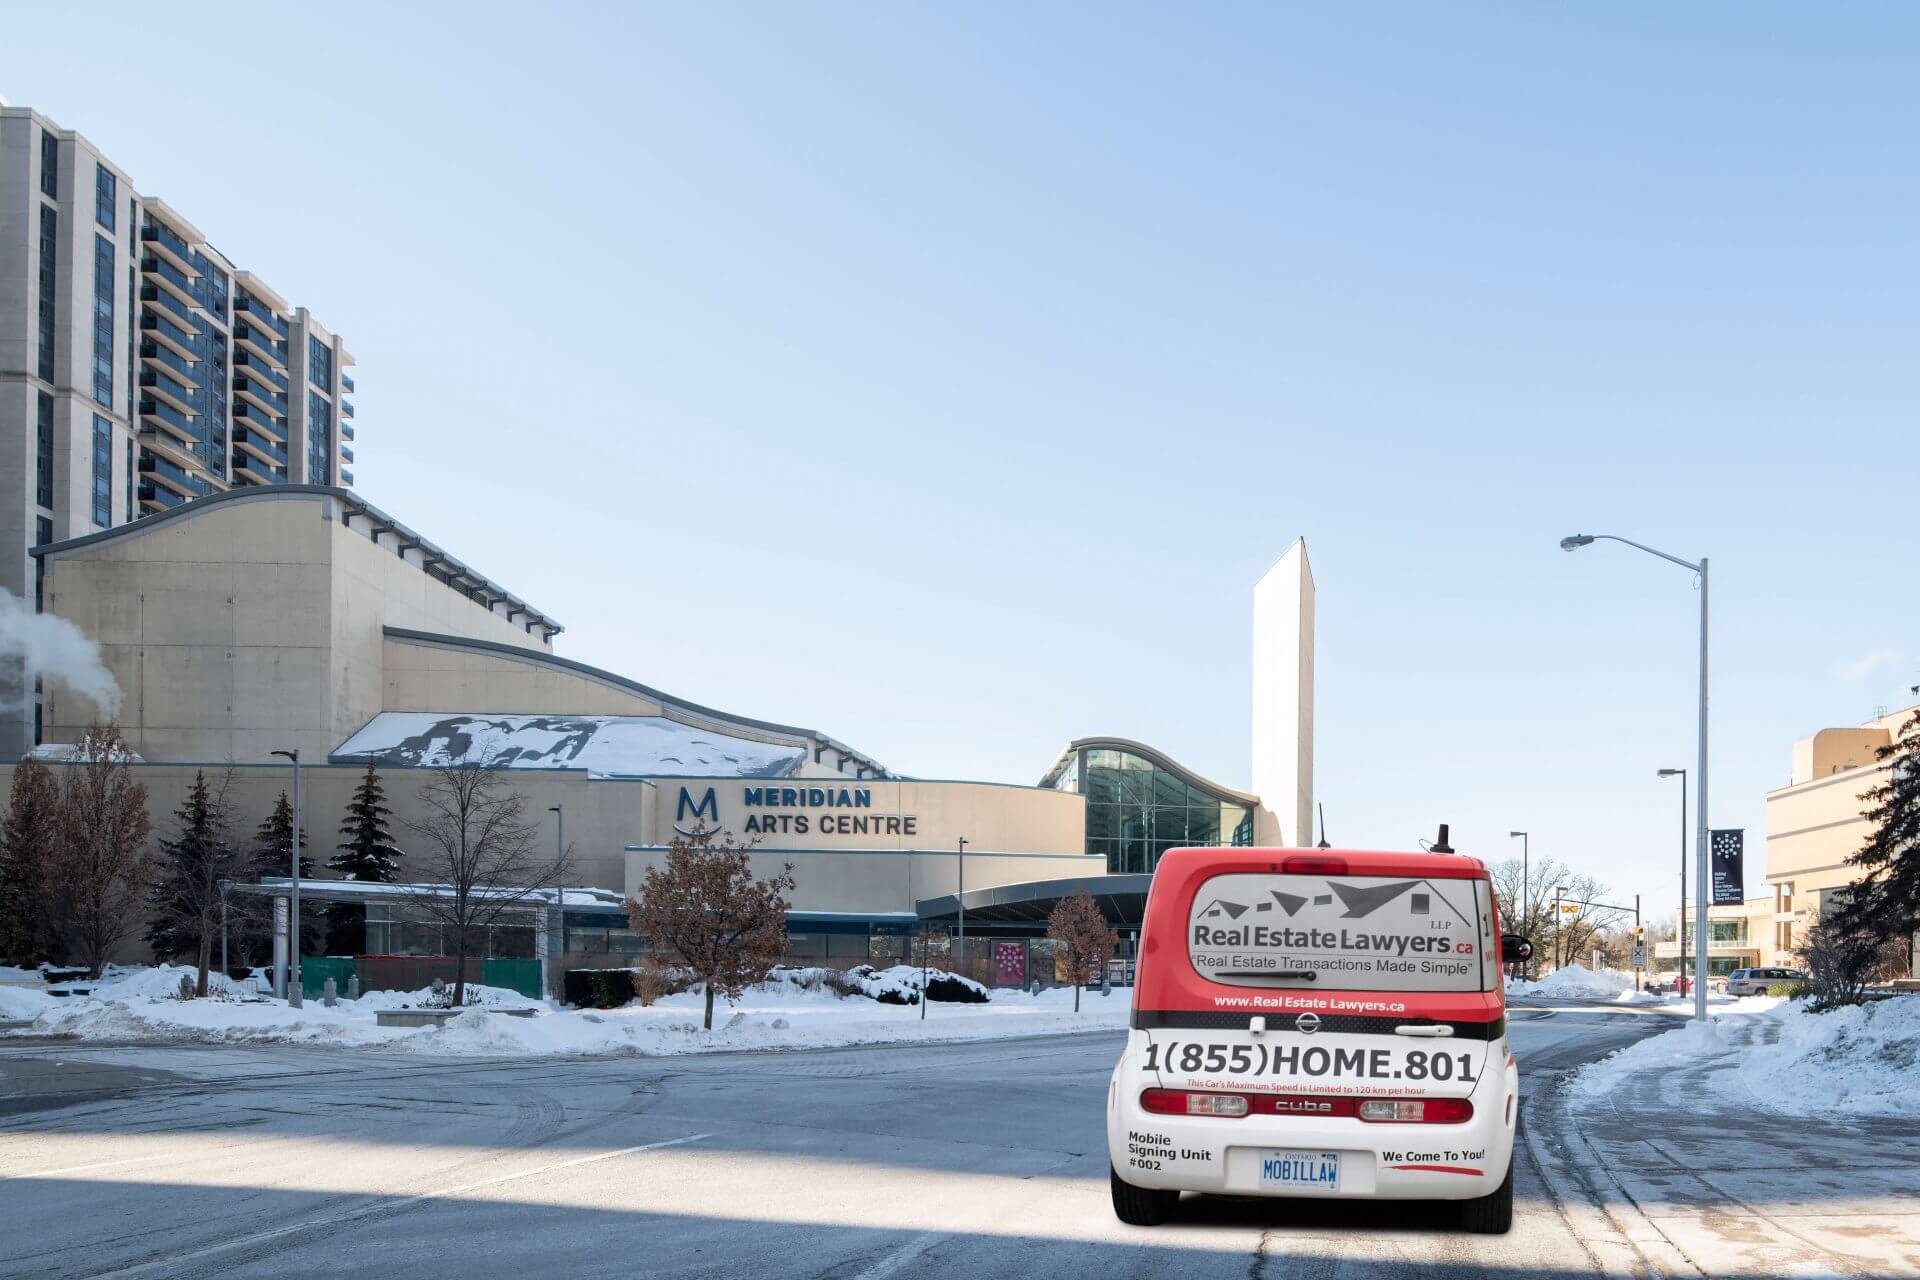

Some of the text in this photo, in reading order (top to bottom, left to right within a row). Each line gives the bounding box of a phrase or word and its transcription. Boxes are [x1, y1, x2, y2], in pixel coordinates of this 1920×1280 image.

[744, 786, 871, 808] MERIDIAN
[744, 814, 917, 835] ARTS CENTRE
[1431, 920, 1451, 930] LLP
[1232, 955, 1277, 968] Estate
[1281, 956, 1372, 971] Transactions
[1376, 959, 1416, 973] Made
[1187, 1079, 1204, 1088] This
[1226, 1081, 1270, 1090] Maximum
[1271, 1083, 1298, 1092] Speed
[1300, 1083, 1307, 1092] is
[1309, 1085, 1342, 1093] Limited
[1343, 1086, 1353, 1094] to
[1355, 1086, 1371, 1094] 120
[1372, 1086, 1387, 1094] km
[1388, 1087, 1403, 1096] per
[1405, 1087, 1426, 1095] hour
[1128, 1131, 1171, 1146] Mobile
[1128, 1143, 1212, 1161] Signing Unit
[1382, 1149, 1486, 1162] We Come To You!
[1129, 1158, 1162, 1171] #002
[1263, 1159, 1337, 1183] MOBILLAW
